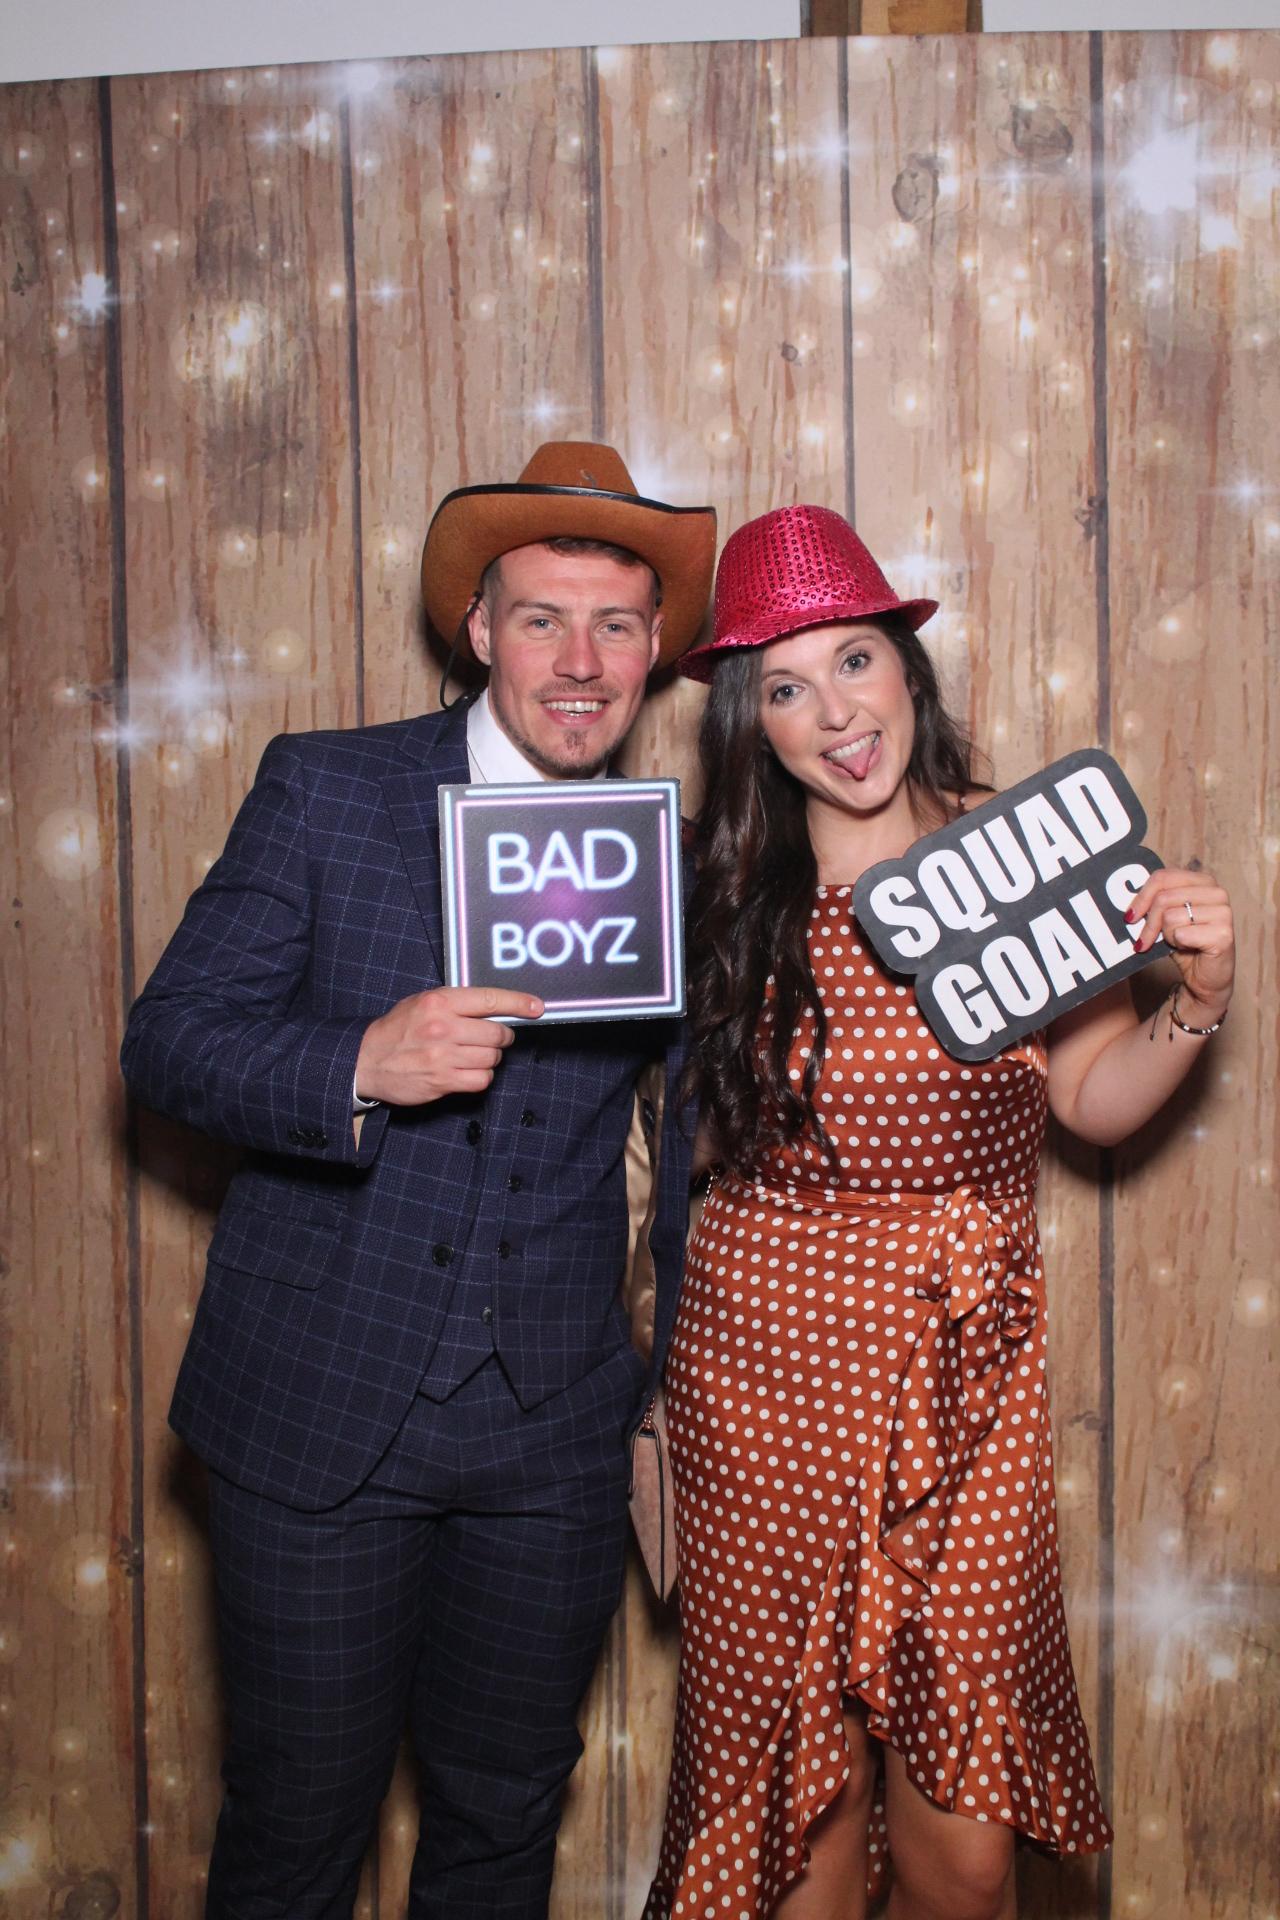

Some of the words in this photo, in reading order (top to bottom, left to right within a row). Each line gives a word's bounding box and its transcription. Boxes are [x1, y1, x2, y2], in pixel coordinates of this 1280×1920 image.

[487, 828, 638, 894] BAD
[869, 766, 1132, 958] SQUAD
[492, 916, 639, 969] BOYZ
